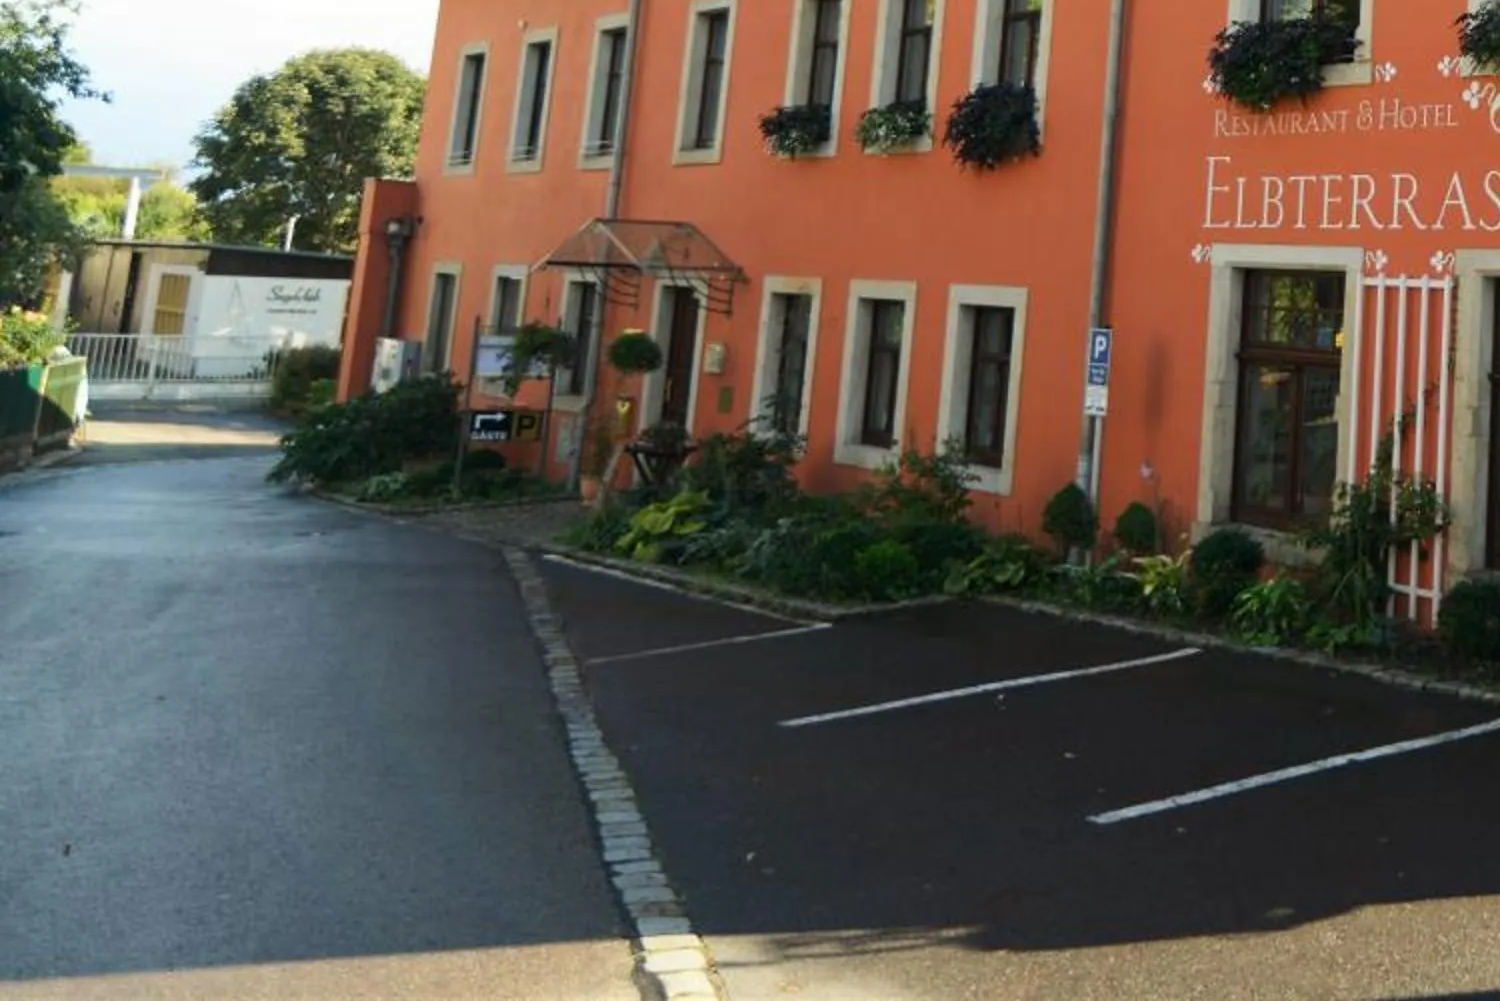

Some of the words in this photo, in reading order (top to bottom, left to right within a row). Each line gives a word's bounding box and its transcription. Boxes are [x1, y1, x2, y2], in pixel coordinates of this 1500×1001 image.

[1214, 109, 1349, 137] RESTAURANT
[1379, 98, 1459, 130] HOTEL
[1095, 335, 1107, 359] P
[517, 415, 536, 437] P
